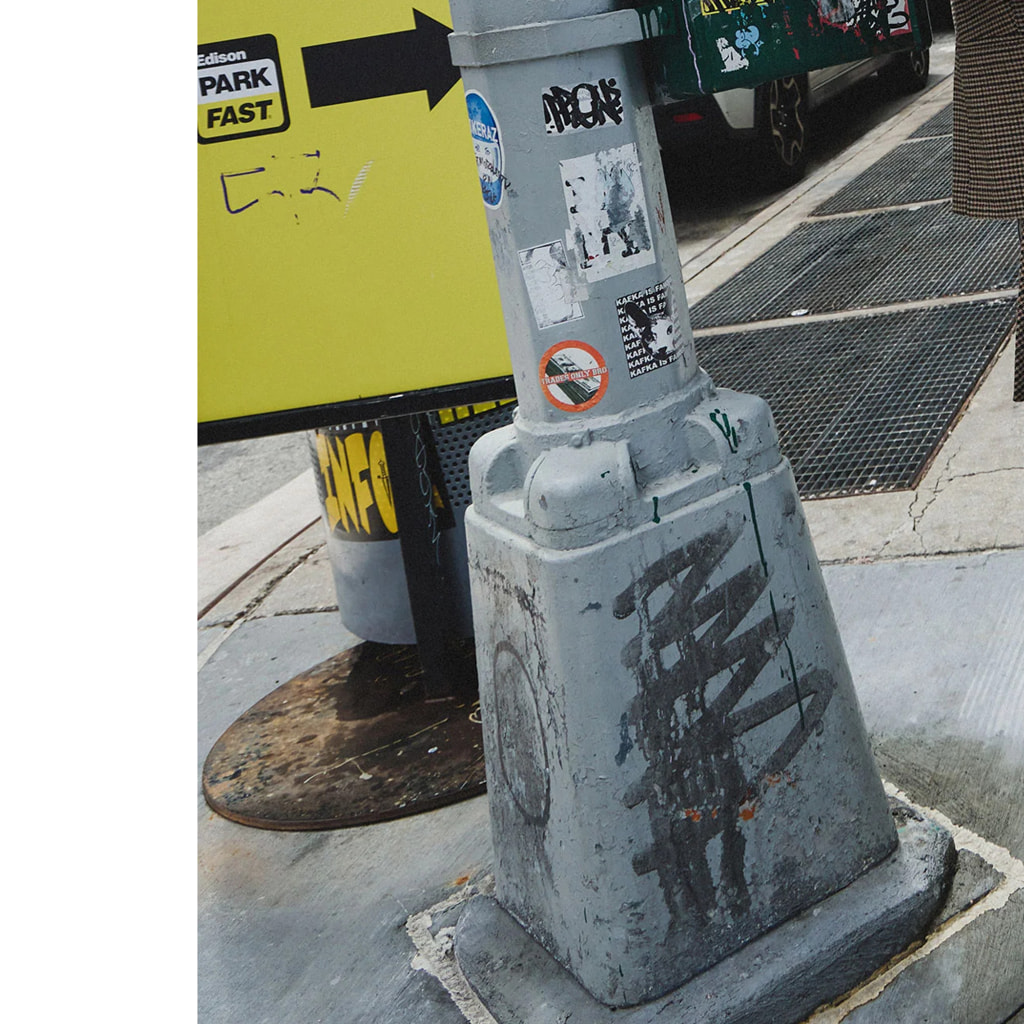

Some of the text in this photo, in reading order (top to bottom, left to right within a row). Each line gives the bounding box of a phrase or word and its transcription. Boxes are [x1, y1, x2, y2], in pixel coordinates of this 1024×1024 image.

[197, 50, 247, 67] Edison
[199, 67, 272, 97] PARK
[207, 99, 273, 129] FAST
[616, 291, 644, 306] KAFKA
[645, 287, 654, 296] IS
[646, 296, 656, 305] IS
[648, 304, 657, 313] IS
[570, 369, 591, 379] ONLY
[592, 366, 608, 376] BRO
[630, 362, 658, 378] KAFKA
[659, 358, 668, 367] IS
